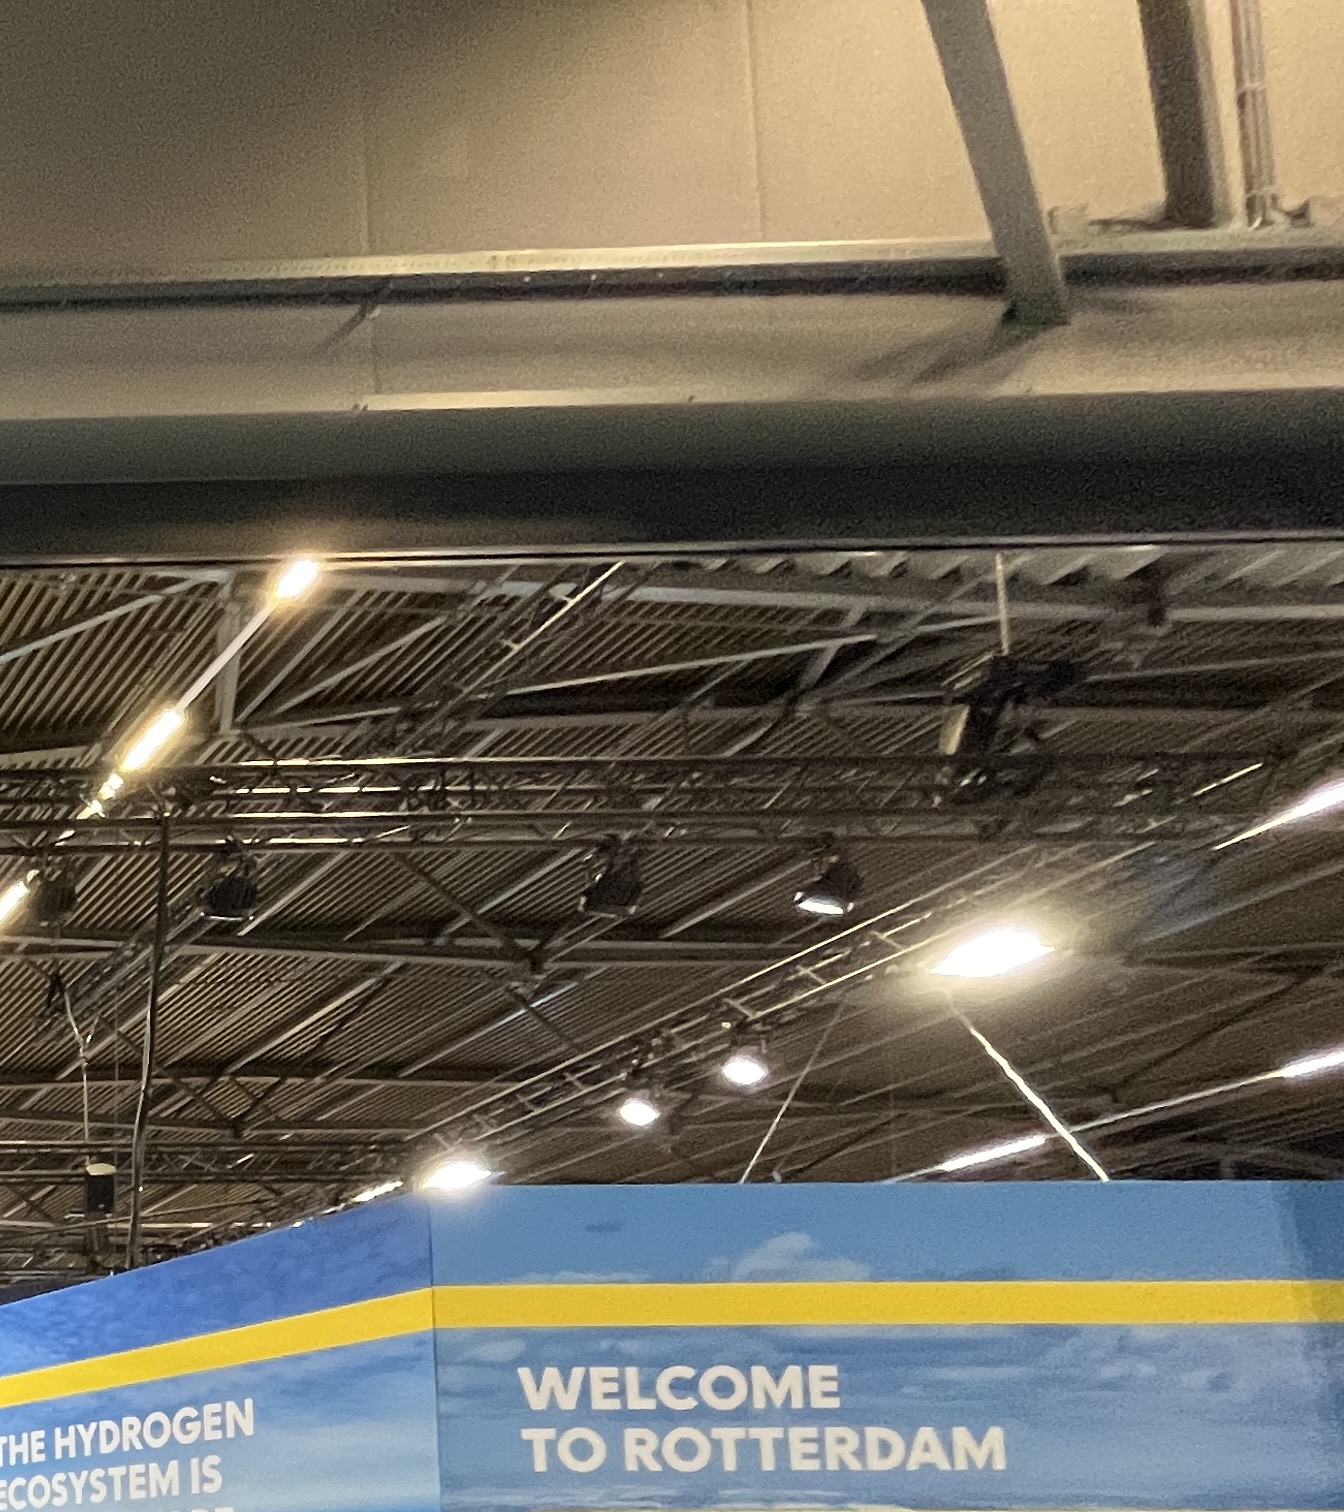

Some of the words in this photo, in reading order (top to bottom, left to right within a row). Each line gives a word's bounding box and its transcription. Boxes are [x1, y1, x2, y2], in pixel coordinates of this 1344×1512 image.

[517, 1364, 841, 1411] WELCOME
[54, 1398, 254, 1460] HYDROGEN
[520, 1427, 607, 1473] TO
[624, 1426, 1007, 1473] ROTTERDAM
[190, 1454, 223, 1494] IS
